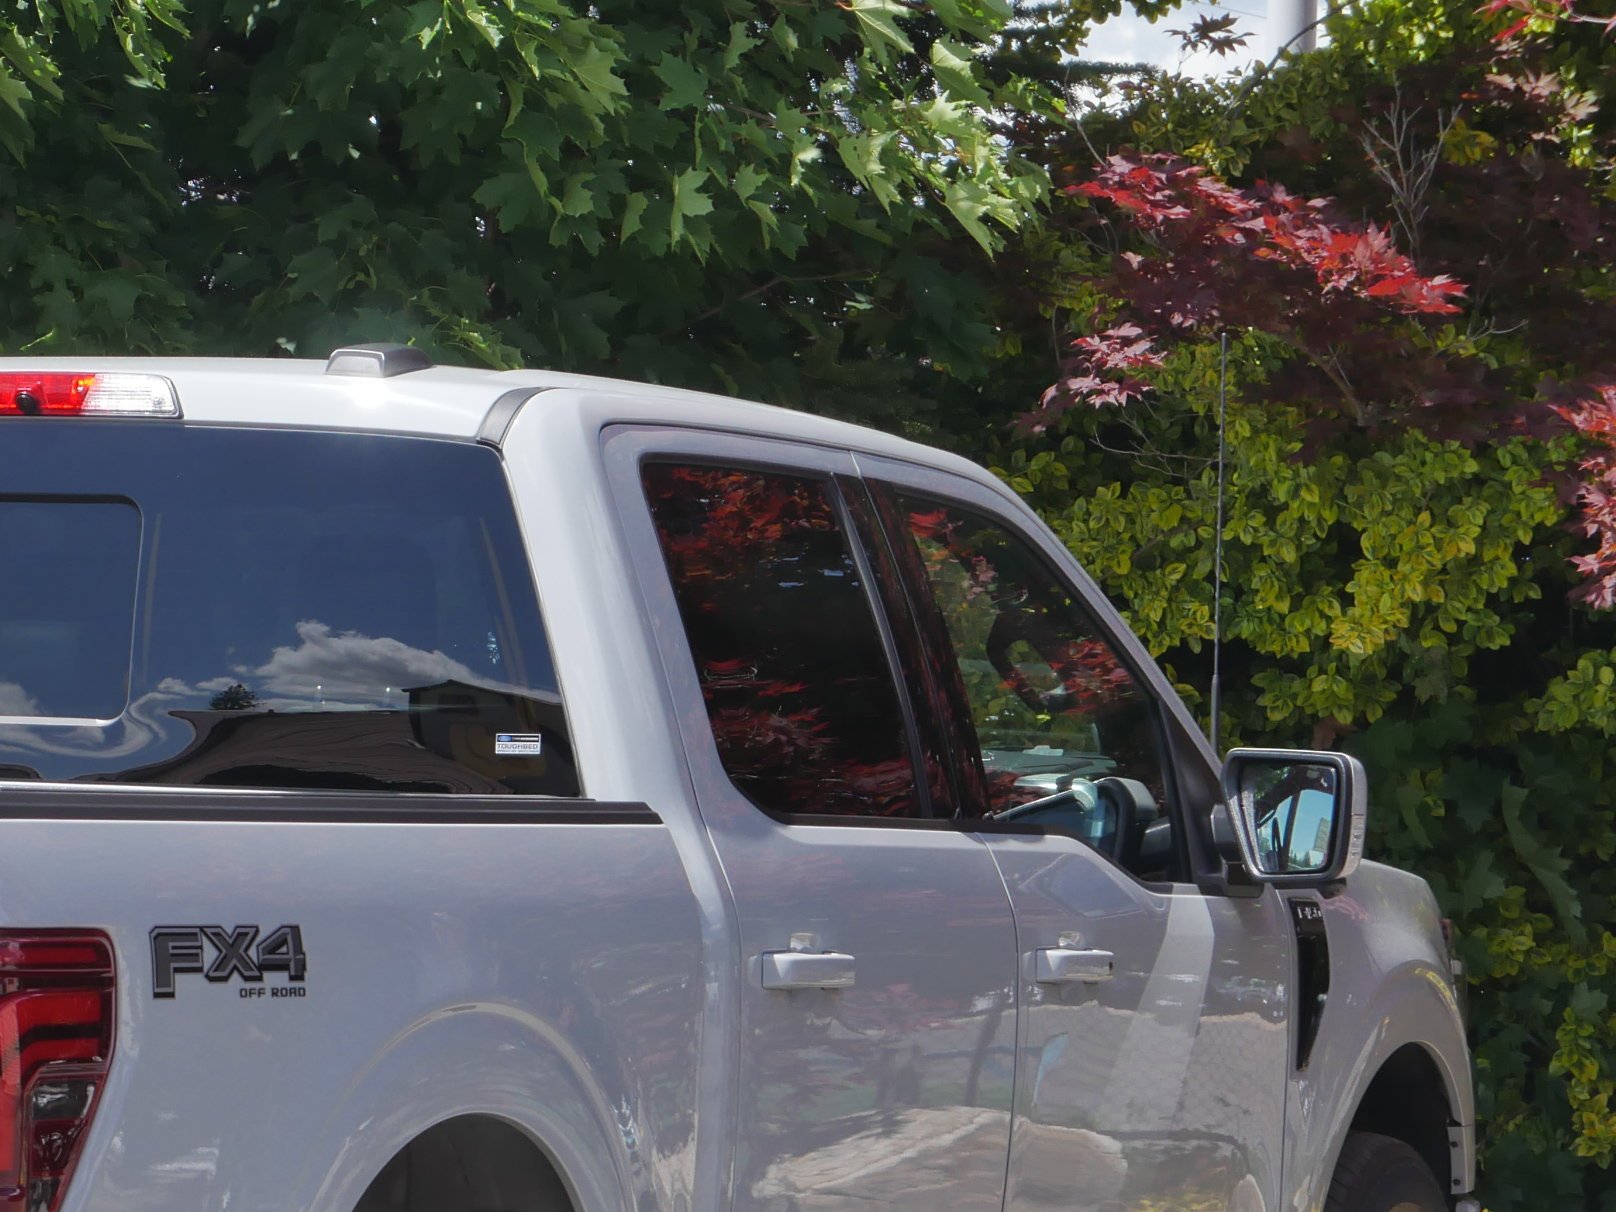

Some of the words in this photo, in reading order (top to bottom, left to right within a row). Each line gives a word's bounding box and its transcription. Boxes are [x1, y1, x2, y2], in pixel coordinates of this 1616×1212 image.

[149, 925, 306, 999] FX4
[239, 987, 266, 998] OFF
[271, 987, 306, 998] ROAD
